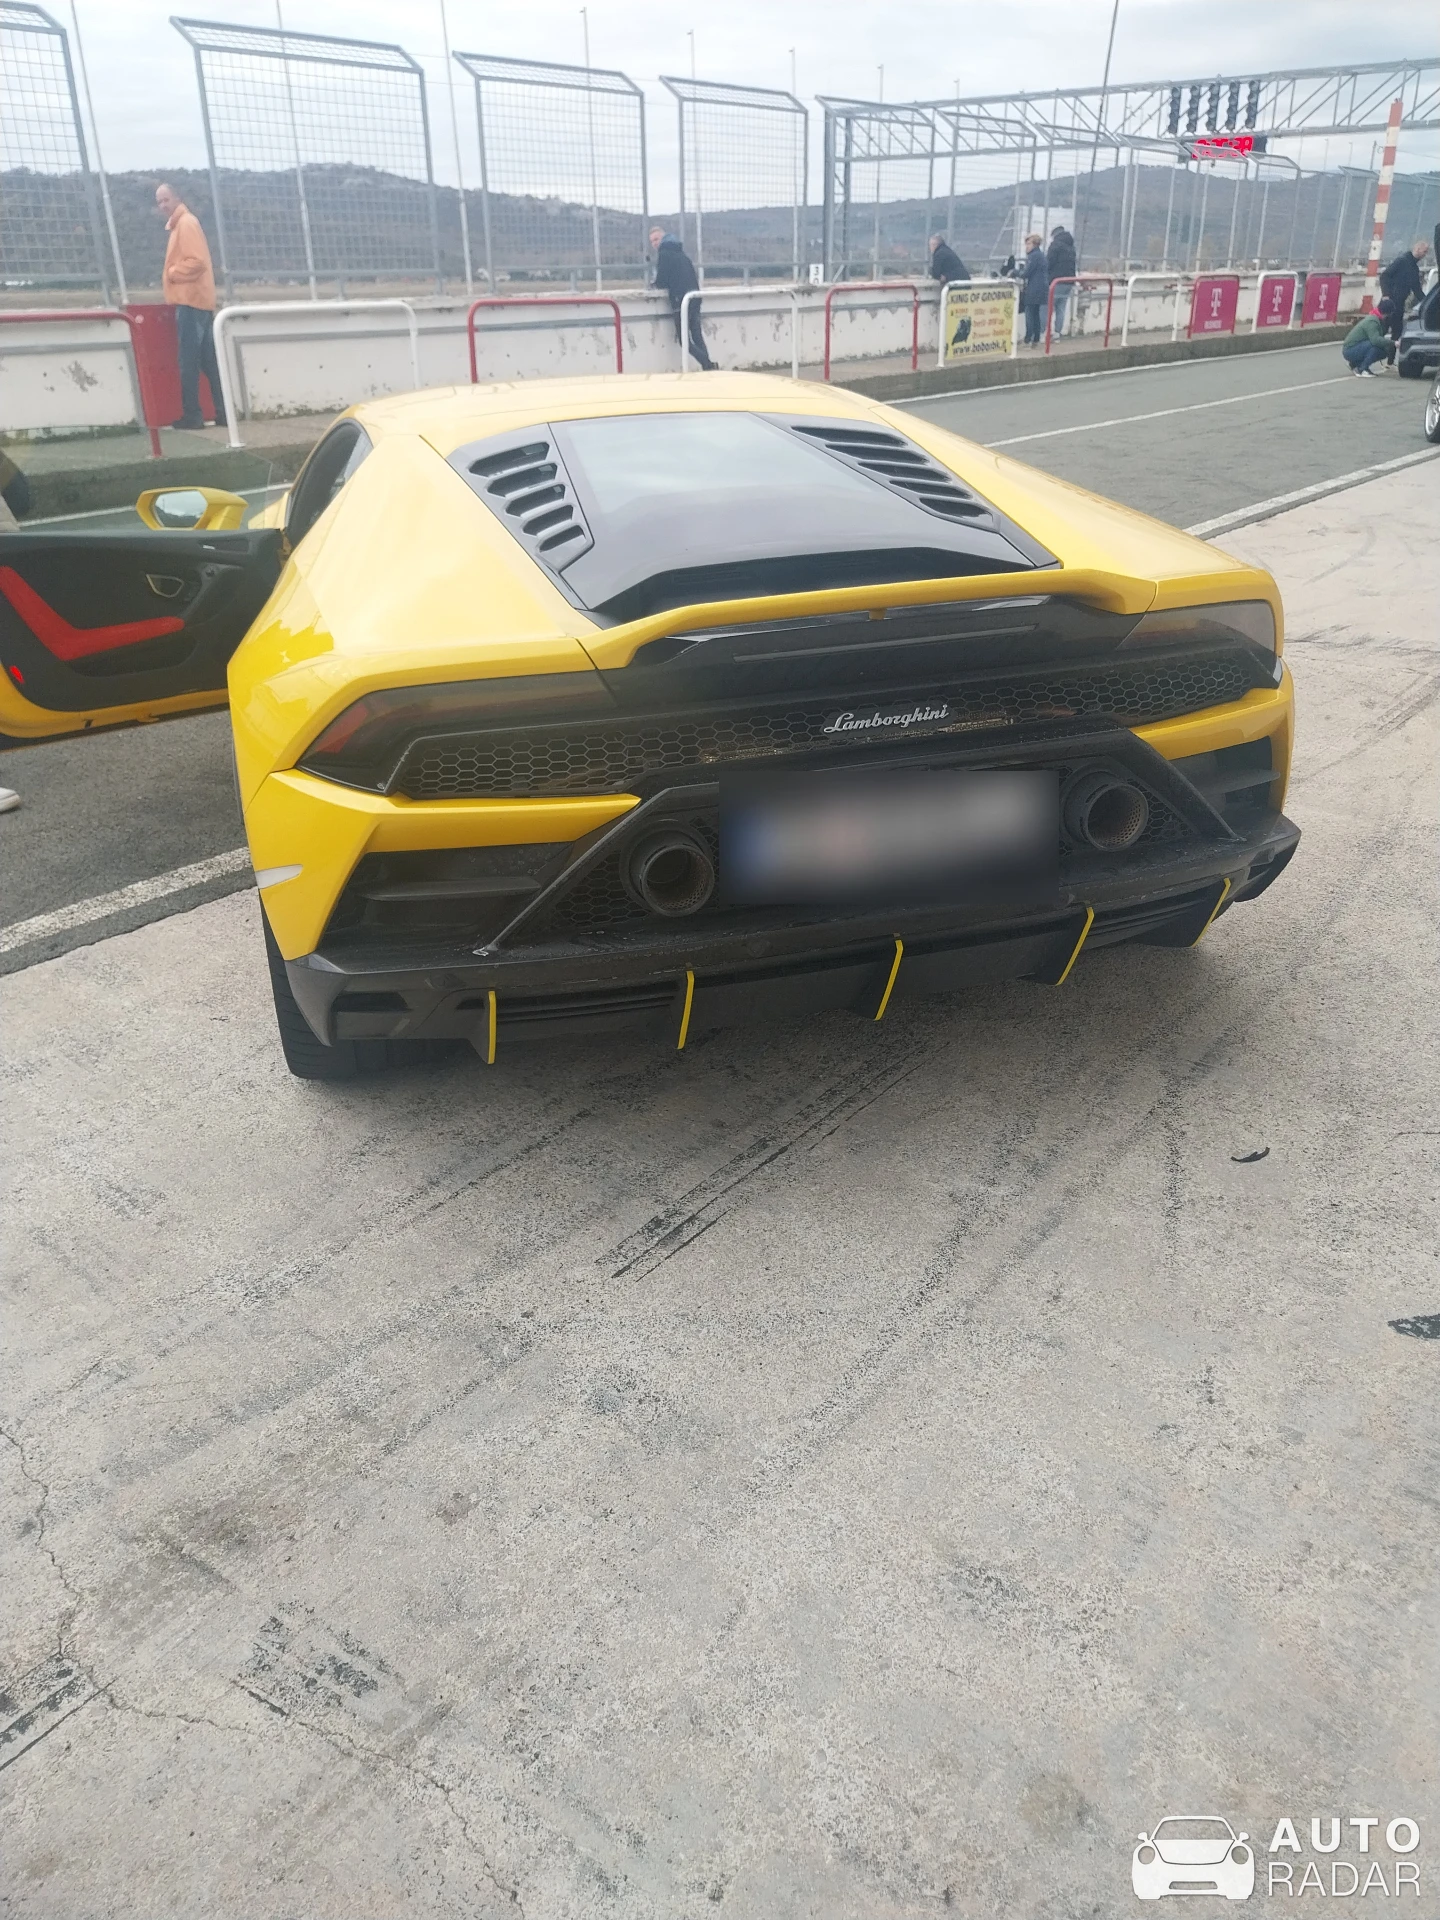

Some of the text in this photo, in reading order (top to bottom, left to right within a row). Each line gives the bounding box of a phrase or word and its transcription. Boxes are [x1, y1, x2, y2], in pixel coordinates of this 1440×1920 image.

[951, 293, 969, 304] KING
[970, 292, 980, 303] OF
[823, 704, 950, 733] Lamborghini
